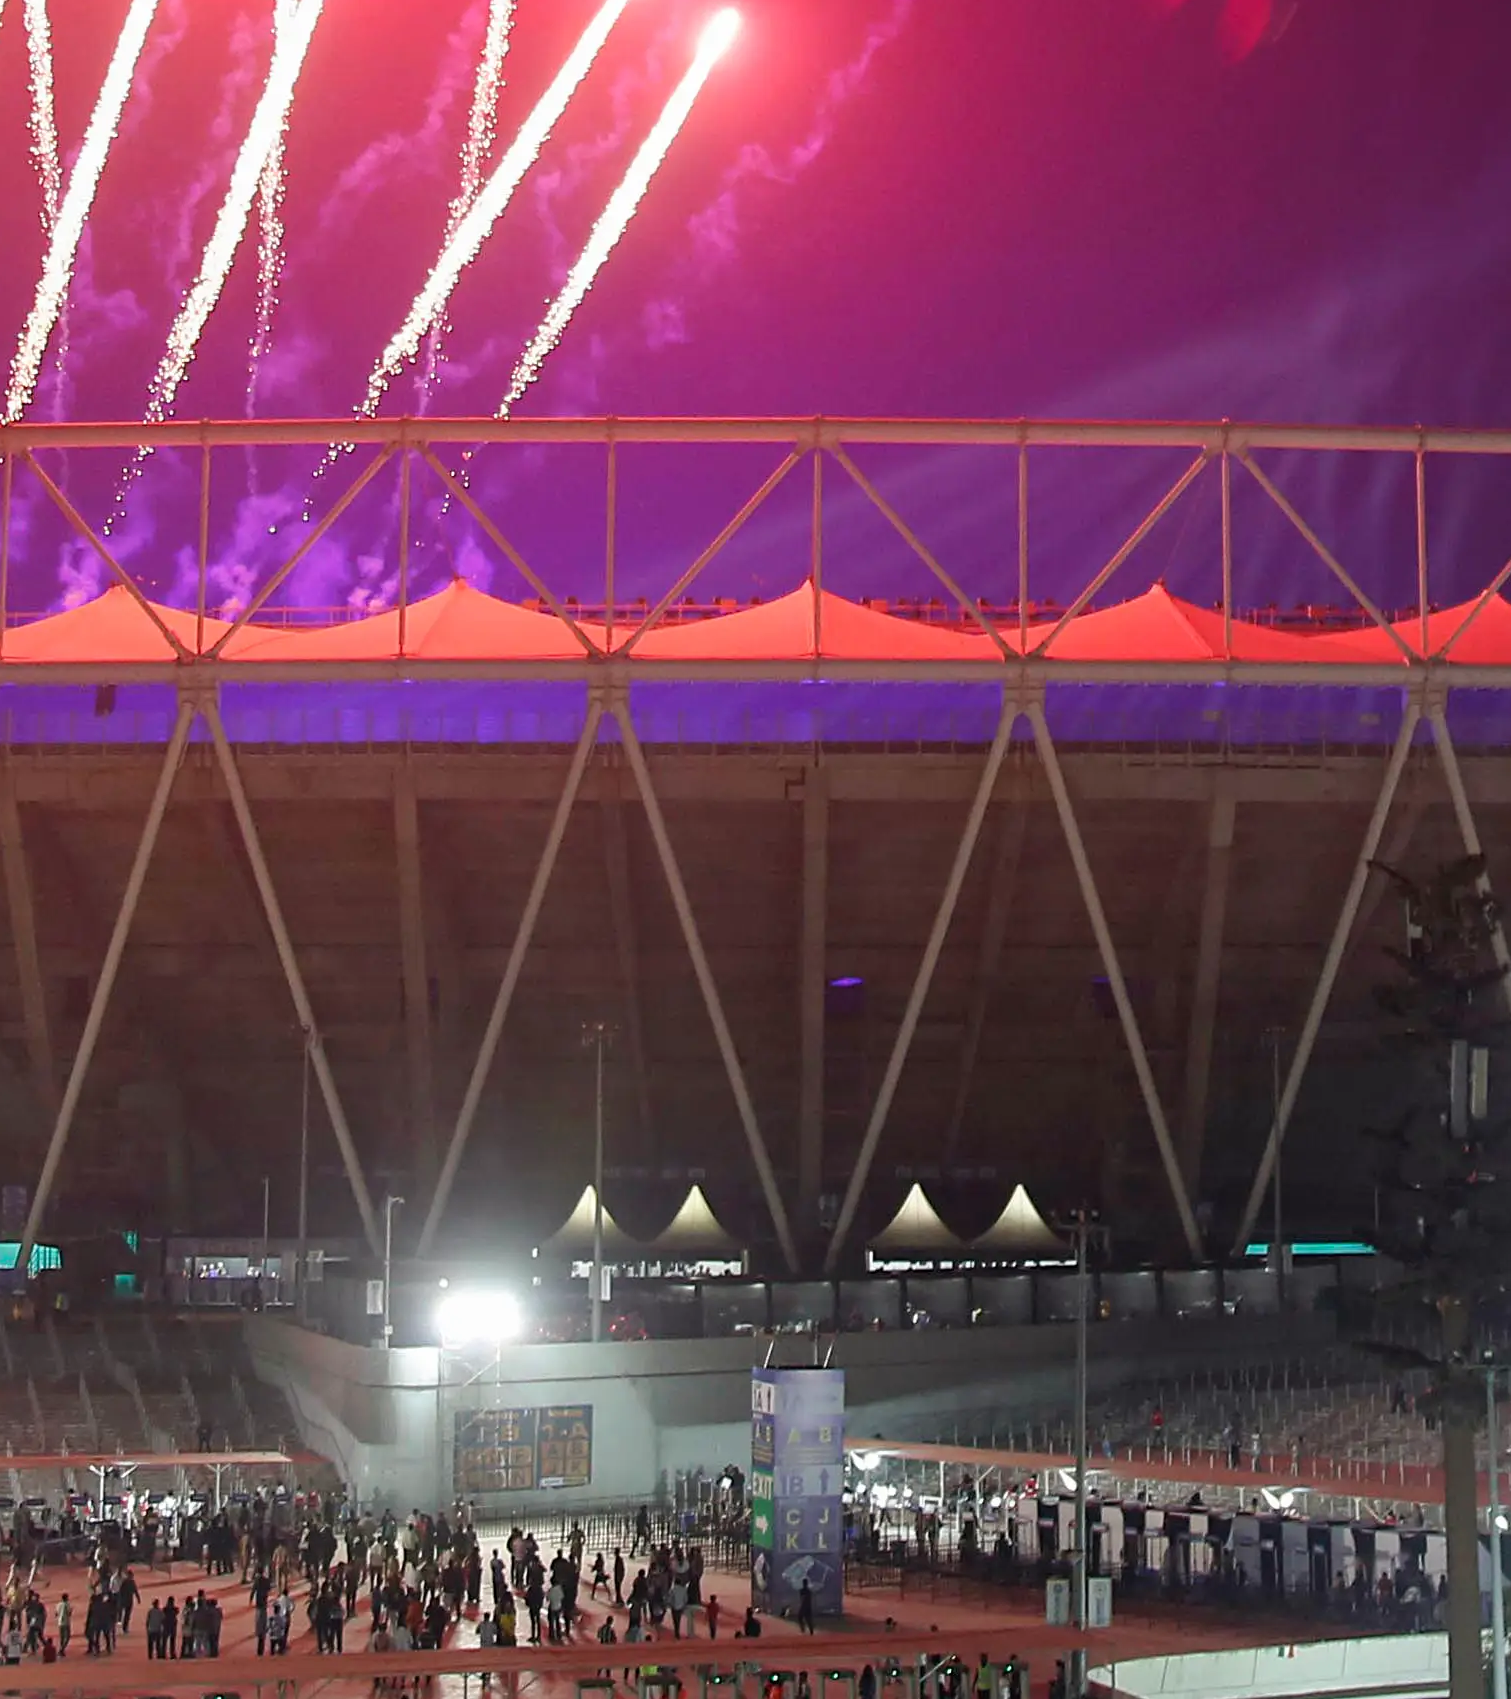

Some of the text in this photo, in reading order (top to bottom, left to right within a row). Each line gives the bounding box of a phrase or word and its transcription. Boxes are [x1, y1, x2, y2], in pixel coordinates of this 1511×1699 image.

[820, 1426, 832, 1443] B
[753, 1471, 773, 1499] EXIT
[781, 1474, 804, 1495] 1B
[786, 1507, 829, 1525] C J
[786, 1532, 828, 1549] K L
